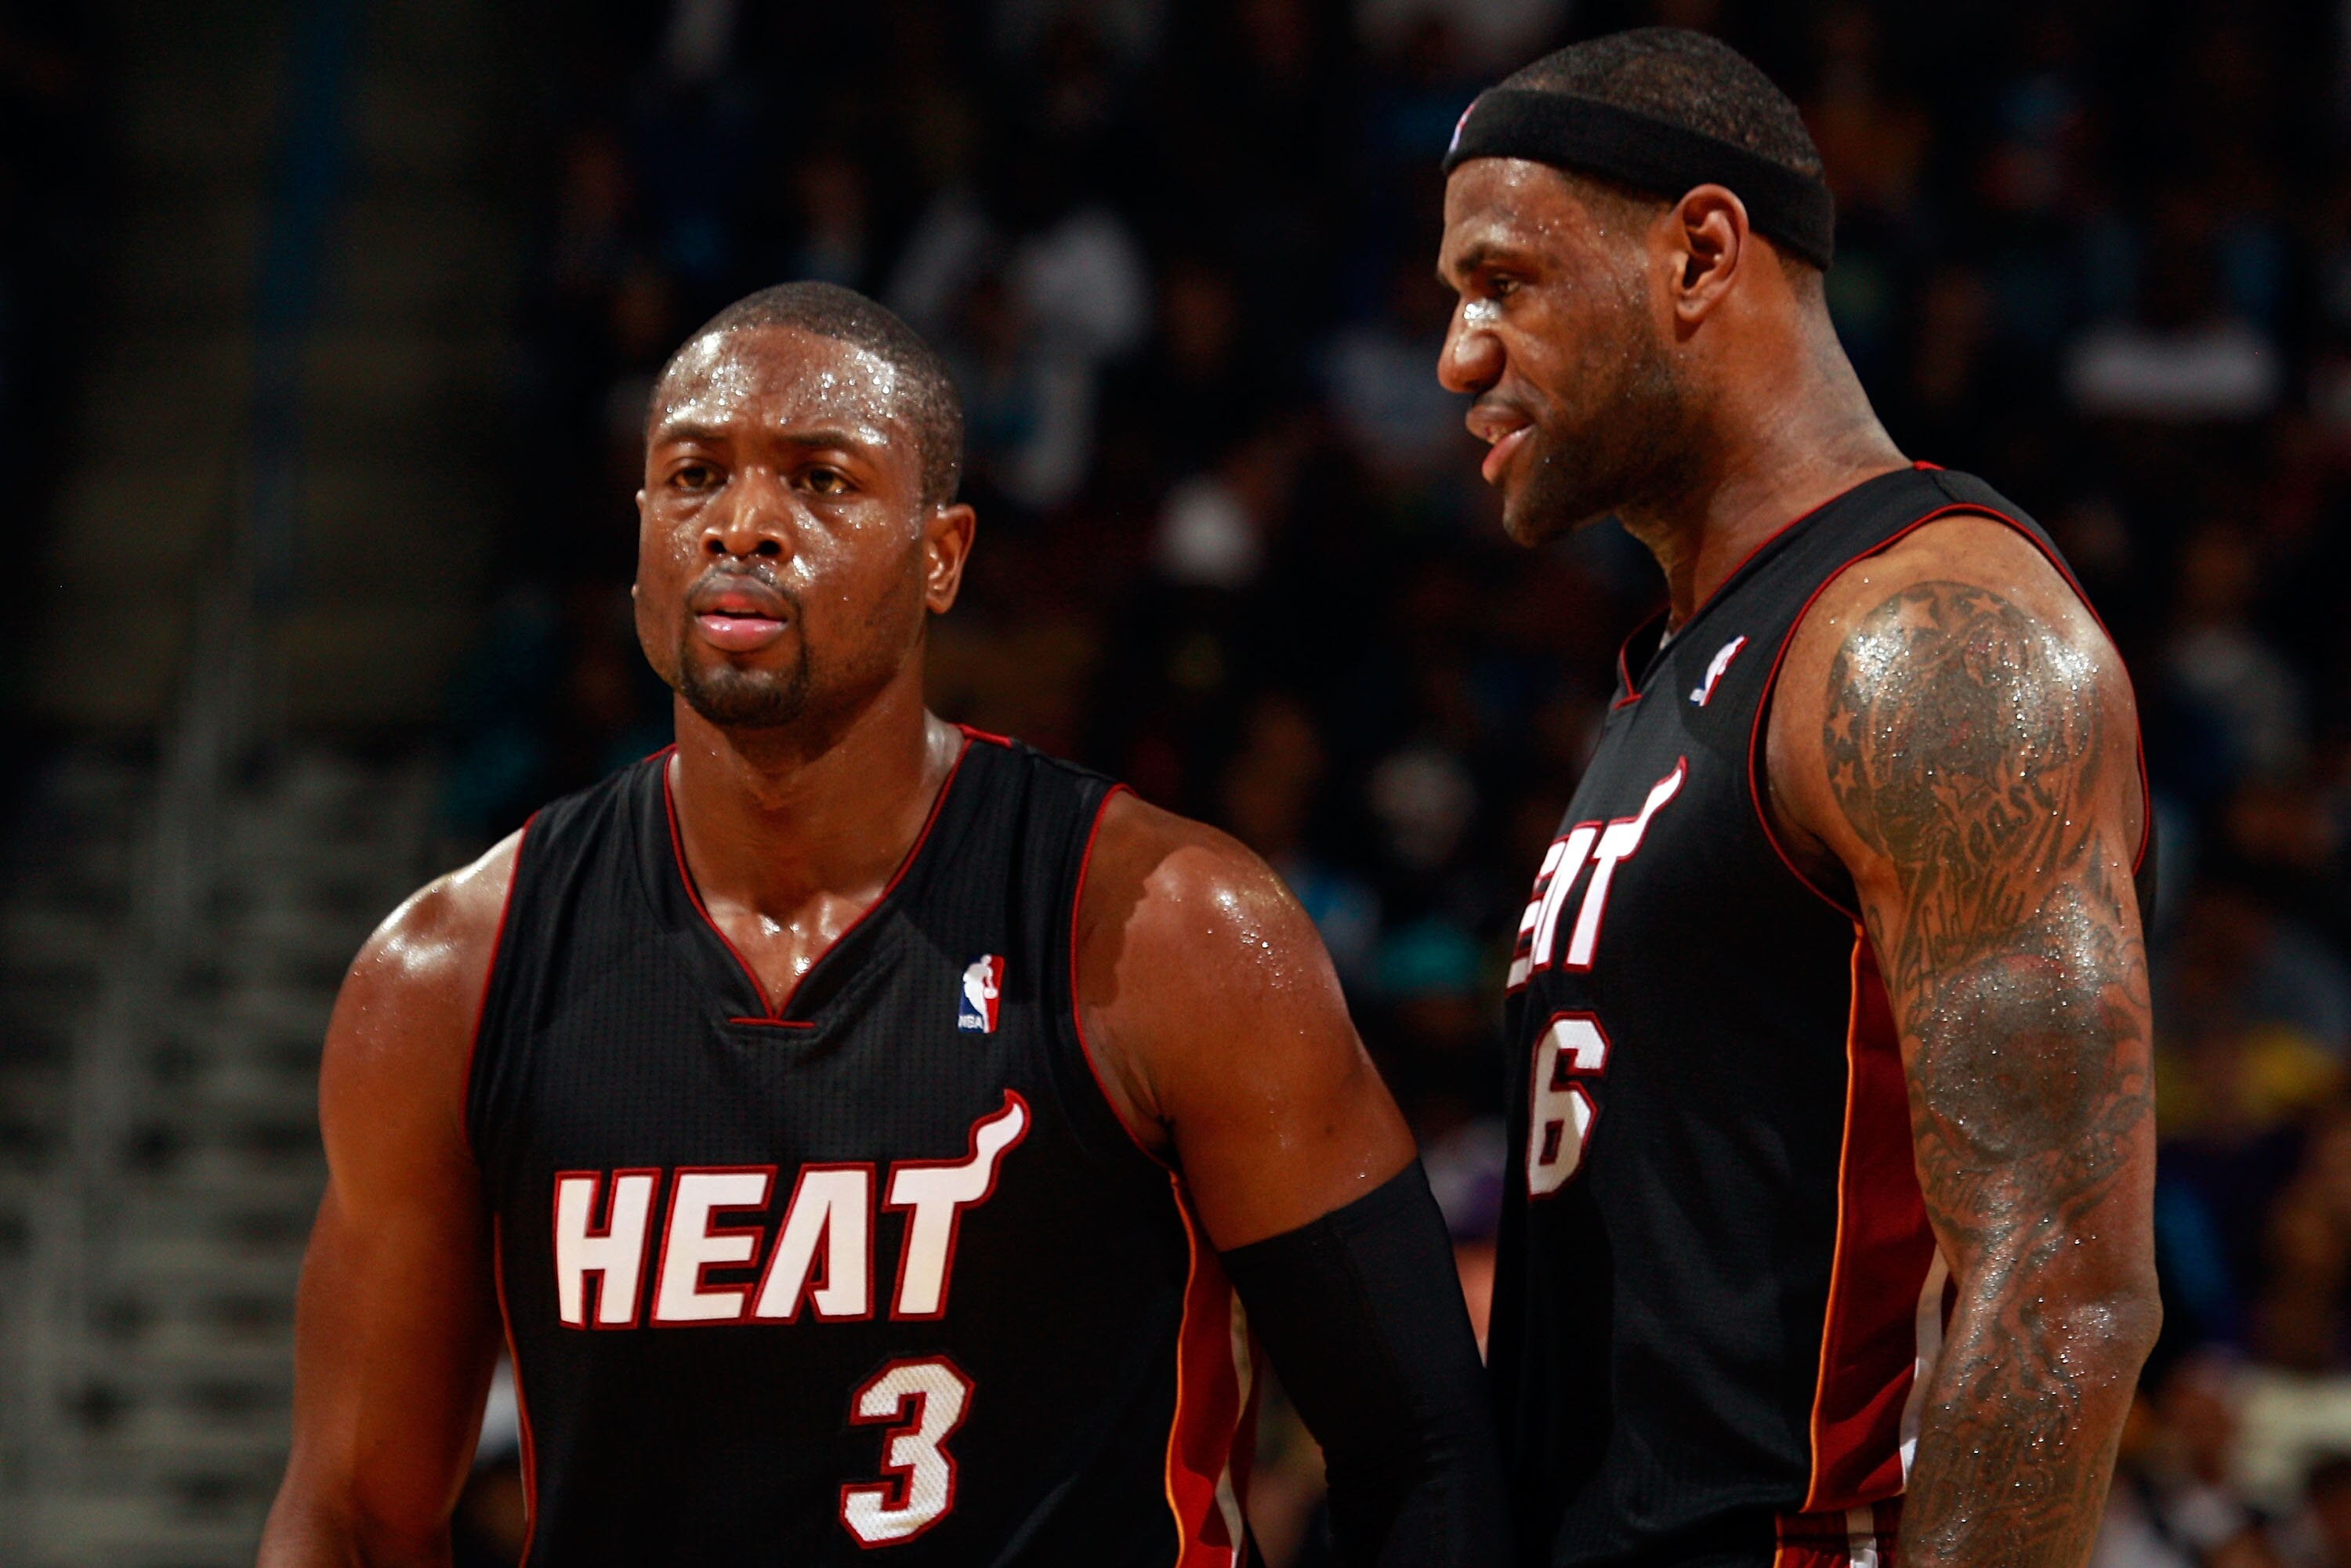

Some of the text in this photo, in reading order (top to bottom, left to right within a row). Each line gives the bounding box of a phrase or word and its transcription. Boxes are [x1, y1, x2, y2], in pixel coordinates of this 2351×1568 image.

[1525, 1011, 1612, 1201] 6
[552, 1088, 1031, 1329] HEAT
[839, 1354, 976, 1549] 3
